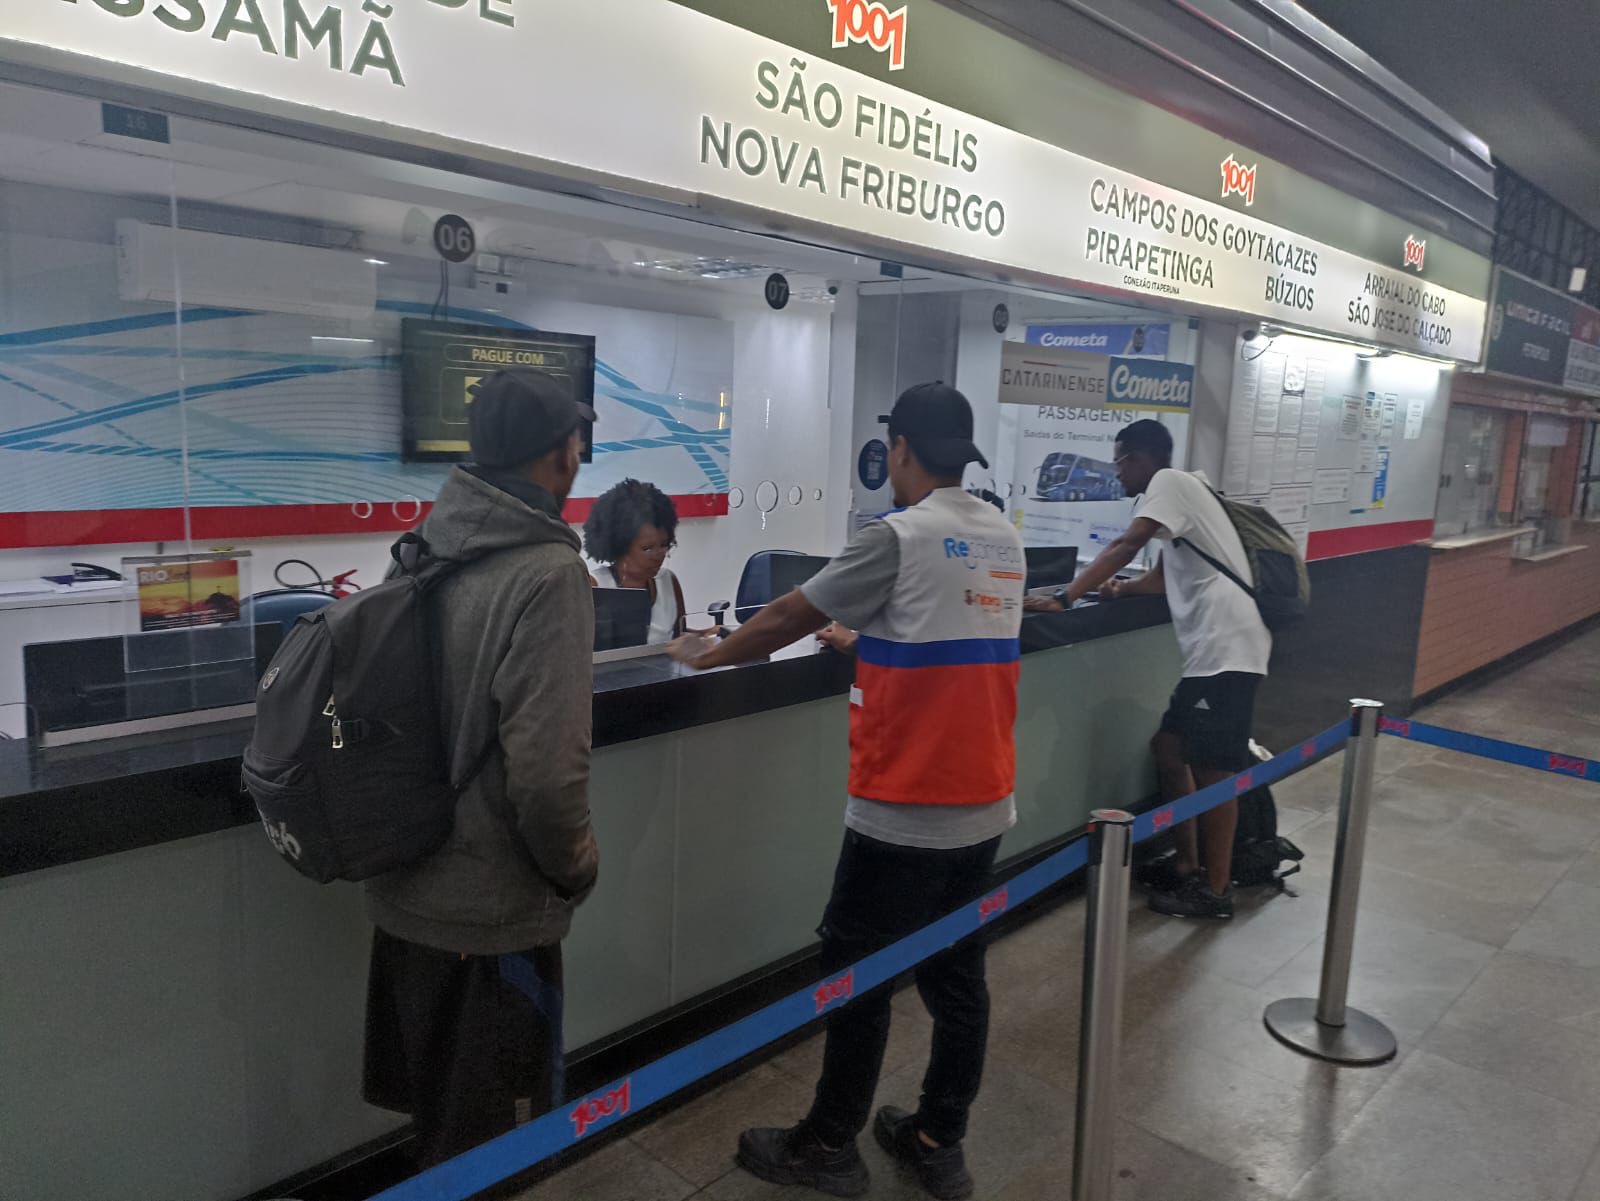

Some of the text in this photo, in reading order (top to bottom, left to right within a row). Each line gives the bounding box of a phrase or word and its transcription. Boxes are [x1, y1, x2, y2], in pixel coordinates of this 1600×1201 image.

[826, 0, 907, 70] 1001
[755, 57, 978, 172] SÃO FIDÉLIS
[700, 115, 1005, 237] NOVA FRIBURGO
[1220, 153, 1257, 206] 1001
[438, 224, 472, 252] 06
[1090, 179, 1318, 276] CAMPOS DOS GOYTACAZES
[1085, 227, 1214, 288] PIRAPETINGA
[1404, 234, 1426, 271] 1001
[768, 280, 787, 302] 07
[1123, 275, 1150, 289] CONEXÃO
[1265, 273, 1314, 312] BÚZIOS
[1363, 272, 1445, 316] ARRAIAL DO CABO
[1040, 332, 1108, 347] Cometa
[1348, 297, 1370, 326] SÃO
[1396, 314, 1410, 334] DO
[1413, 318, 1452, 345] CALÇADO
[472, 348, 544, 365] PAGUE COM
[1002, 364, 1191, 403] CATARINENSE Cometa
[568, 1077, 631, 1138] 1001
